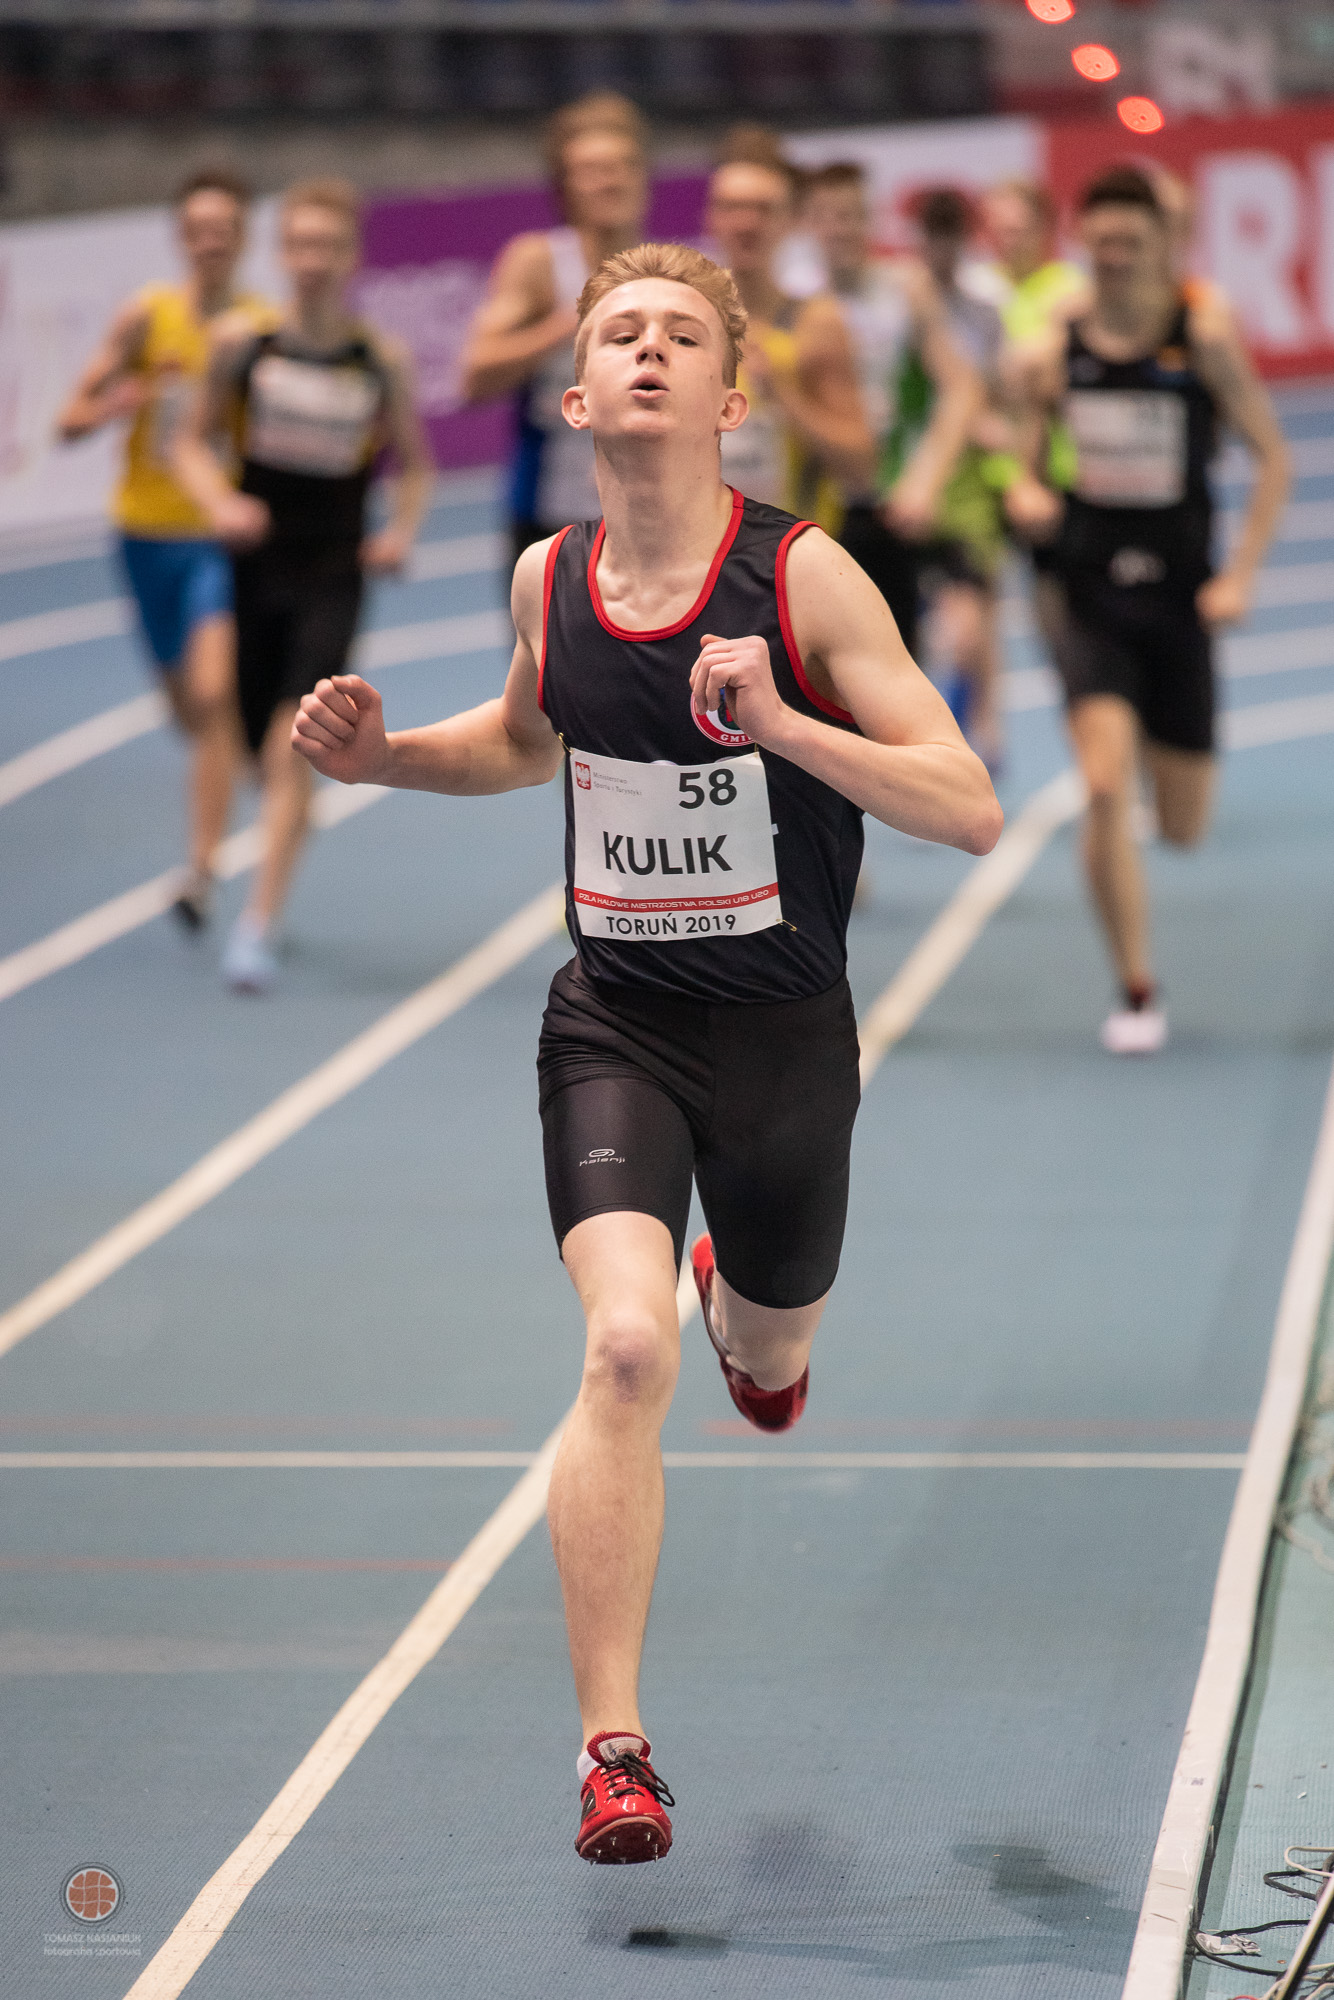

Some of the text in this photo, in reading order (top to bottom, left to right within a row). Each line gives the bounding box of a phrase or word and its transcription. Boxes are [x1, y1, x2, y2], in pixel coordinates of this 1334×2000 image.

[678, 768, 737, 809] 58
[603, 831, 733, 875] KULIK
[579, 889, 769, 909] PZLA HALOWE MISTRZOSTWA POLSKI U18 U20
[606, 912, 736, 936] TORUŃ 2019
